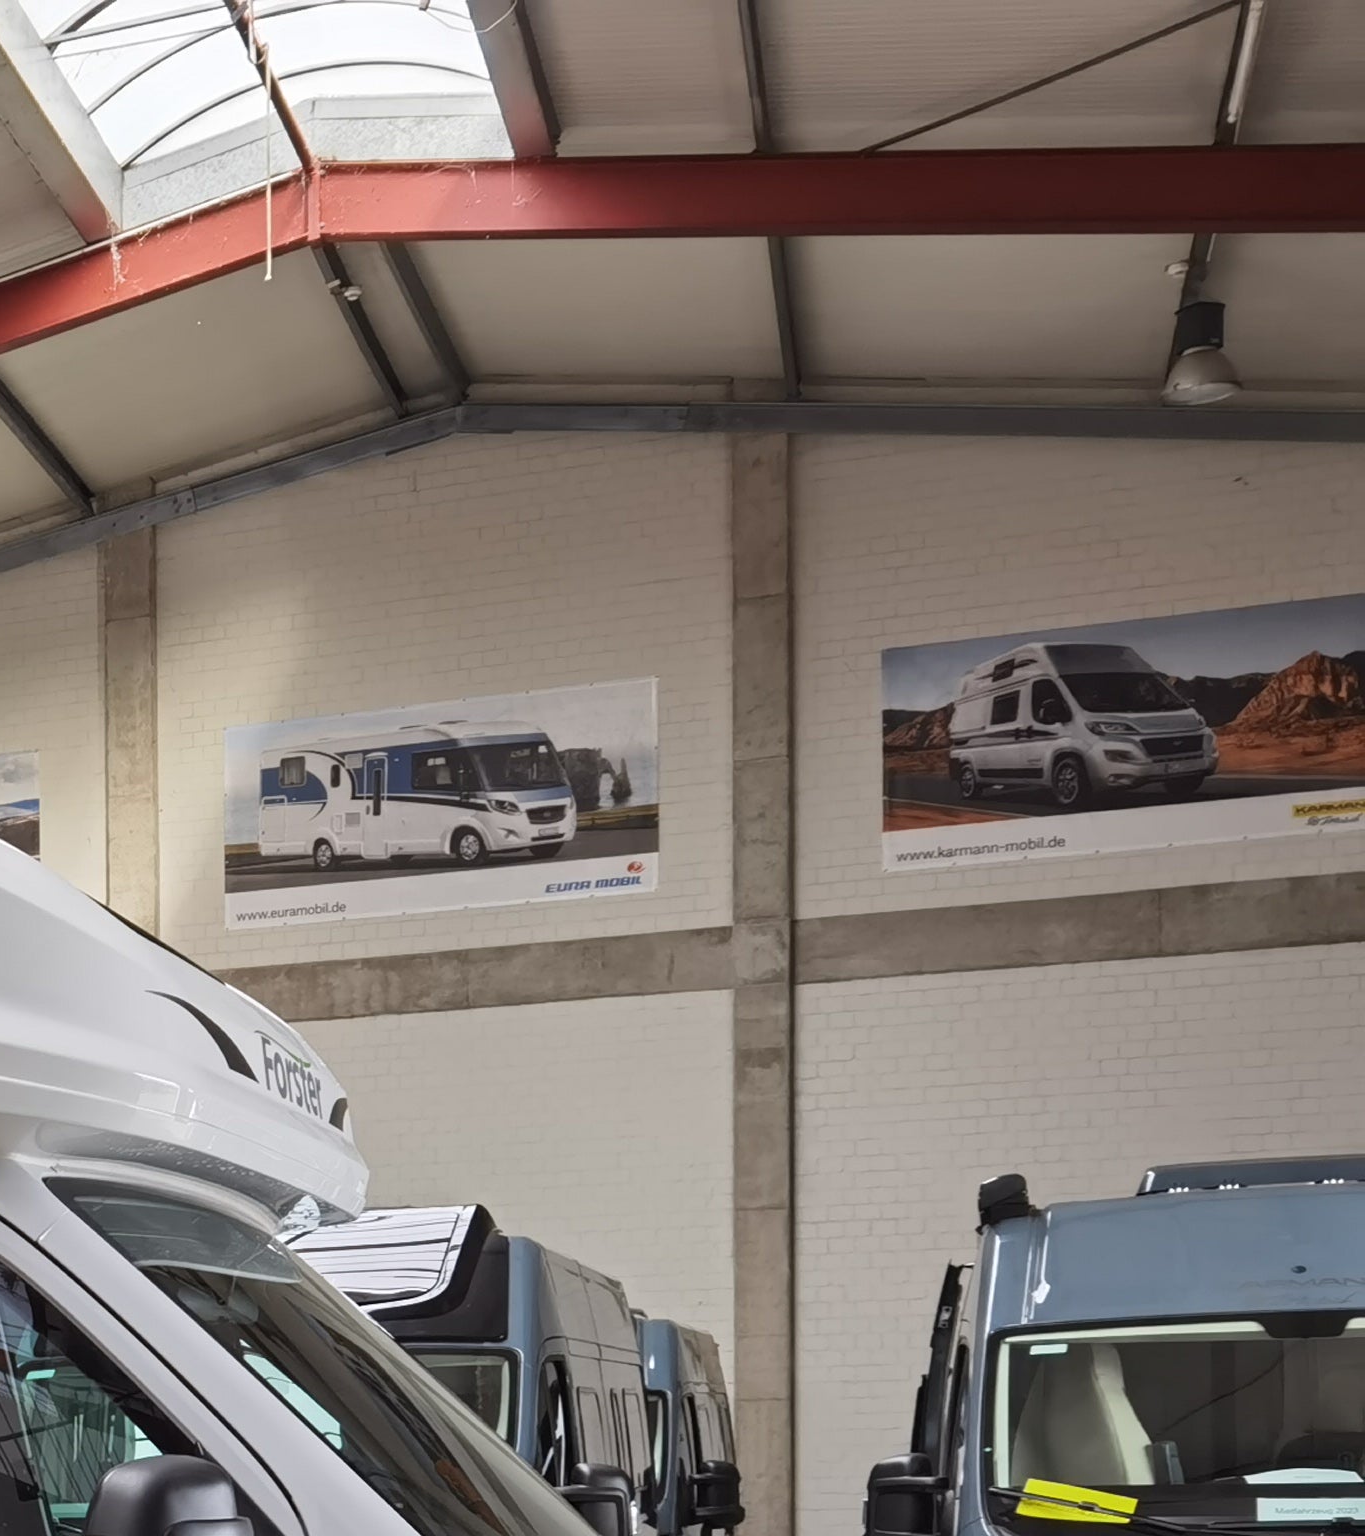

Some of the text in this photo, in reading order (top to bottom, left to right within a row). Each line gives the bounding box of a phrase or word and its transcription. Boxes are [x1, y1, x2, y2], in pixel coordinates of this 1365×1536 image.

[896, 836, 1067, 862] www.karmann-mobil.de
[545, 876, 643, 893] EURA MOBIL
[236, 901, 347, 921] www.euramobil.de
[260, 1035, 323, 1120] Forster
